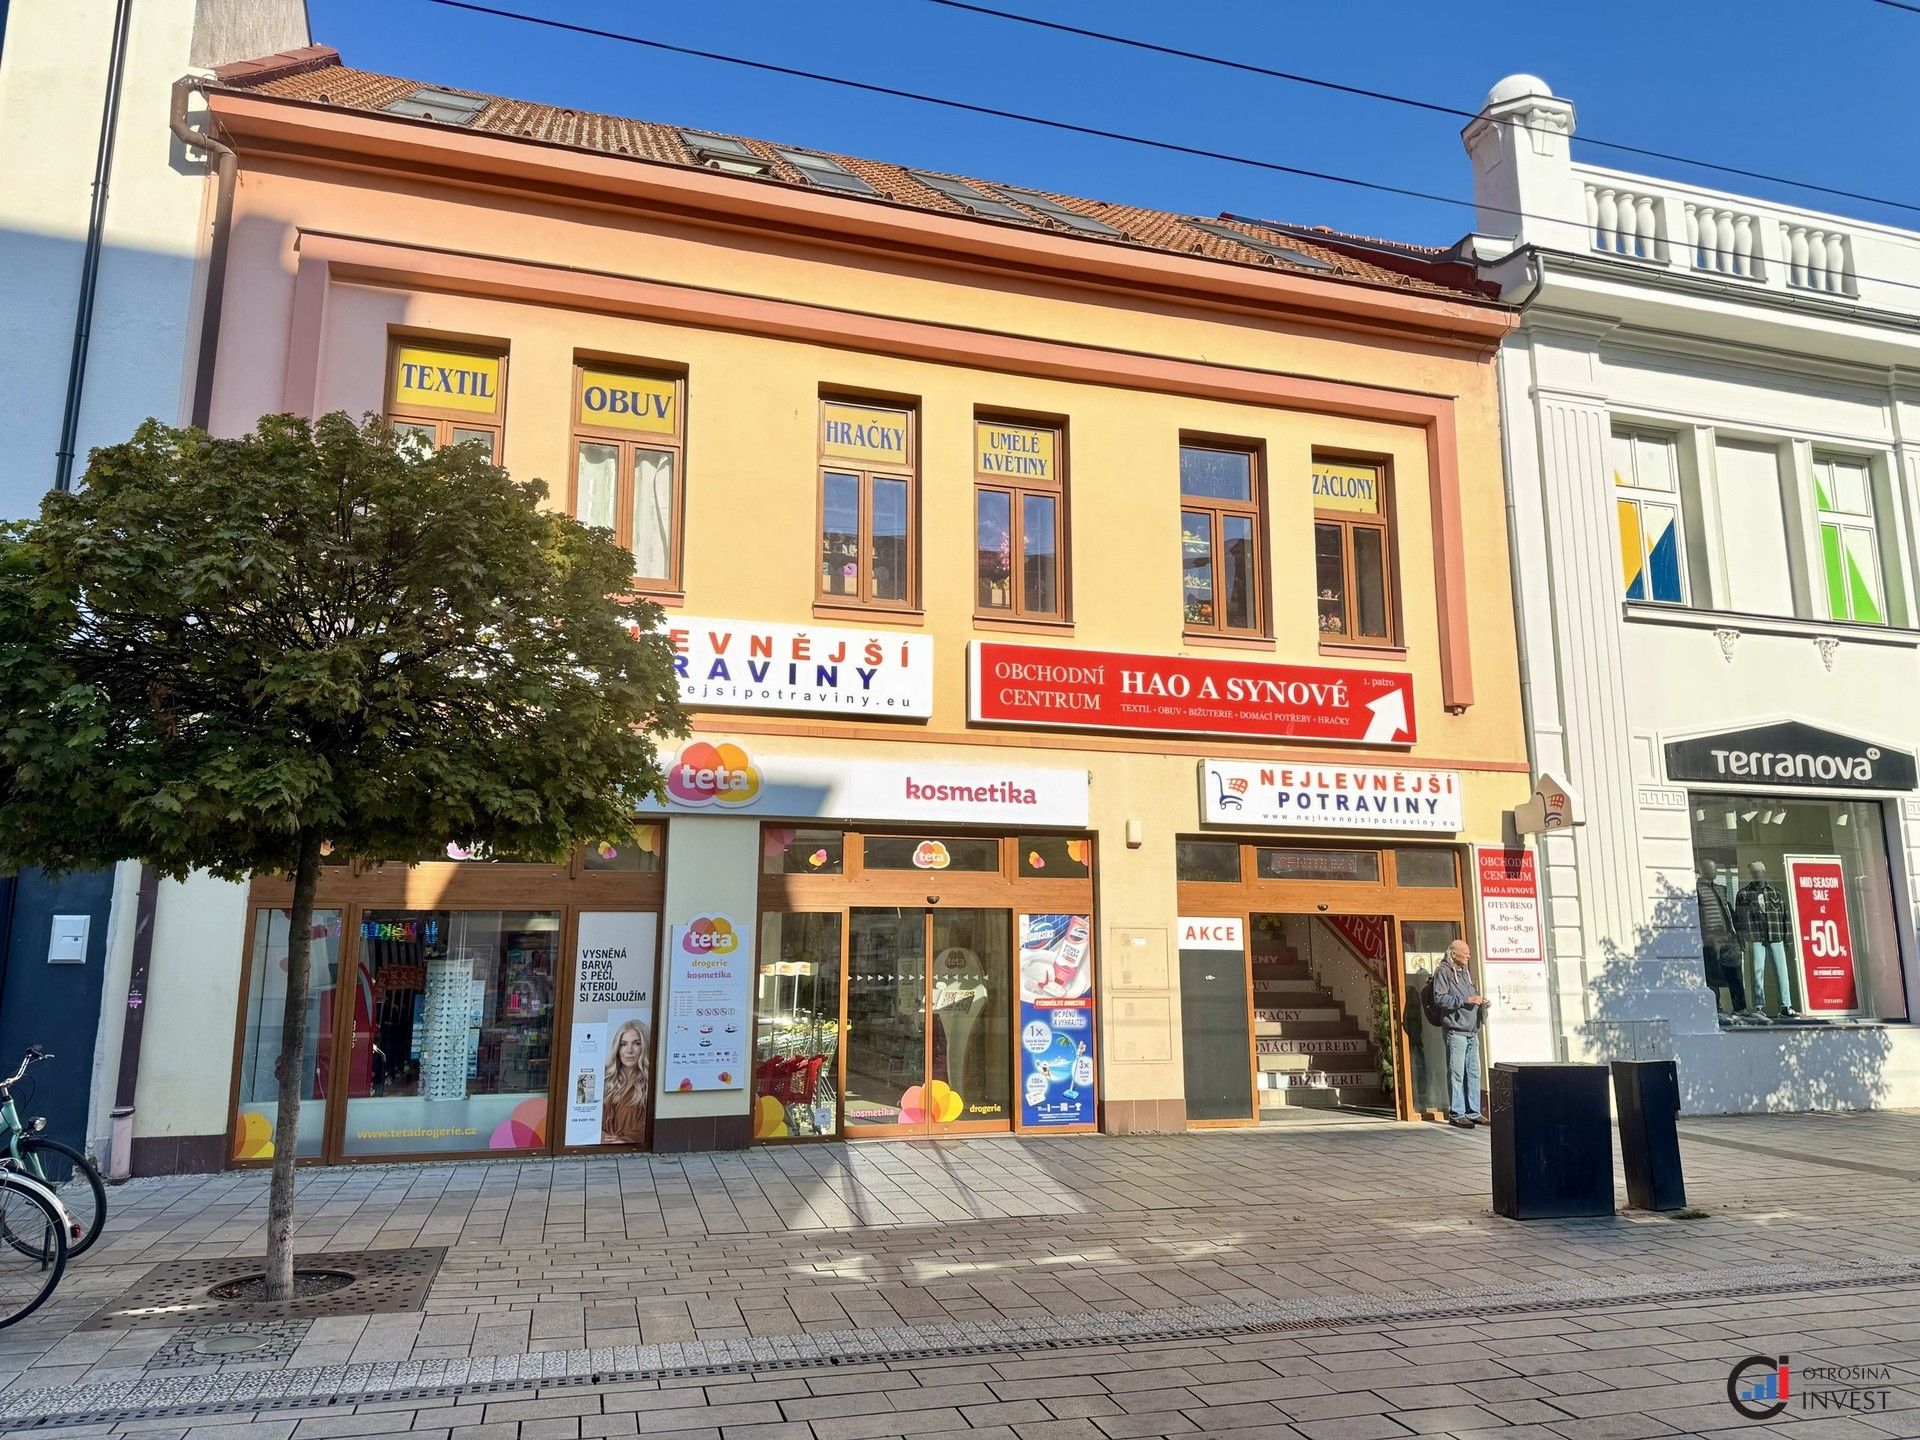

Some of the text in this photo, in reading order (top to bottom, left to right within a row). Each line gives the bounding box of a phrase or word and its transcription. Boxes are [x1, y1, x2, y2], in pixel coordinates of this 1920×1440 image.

[401, 362, 495, 399] TEXTIL
[584, 386, 673, 419] OBUV
[825, 419, 905, 451] HRAČKY
[990, 430, 1040, 454] UMĚLÉ
[982, 451, 1047, 477] KVĚTINY
[1312, 469, 1374, 500] ZÁCLONY
[995, 661, 1350, 708] OBCHODNÍ HAO A SYNOVÉ
[1372, 678, 1395, 688] patro
[999, 688, 1101, 711] CENTRUM
[1120, 703, 1350, 726] TEXTIL OBUV BIŽUTERIE DOMÁCÍ POTŘEBY HRAČKY
[680, 764, 750, 790] teta
[1260, 768, 1453, 794] NEJLEVNĚJŠÍ
[906, 776, 1037, 805] kosmetika
[1278, 791, 1438, 815] POTRAVINY
[919, 851, 944, 863] teta
[1480, 855, 1533, 868] OBCHODNÍ
[1483, 870, 1532, 882] CENTRUM
[1800, 876, 1839, 889] MID SEASON
[1483, 886, 1500, 894] HAO
[1507, 886, 1535, 895] SYNOVÉ
[1812, 889, 1830, 901] SALE
[1488, 901, 1533, 910] OTEVŘENO
[690, 931, 732, 947] teta
[1185, 925, 1236, 941] AKCE
[1803, 919, 1848, 957] -50%
[1508, 937, 1519, 945] Ne
[582, 947, 627, 959] VYSNĚNÁ
[581, 960, 613, 970] BARVA
[691, 958, 728, 968] drogerie
[581, 971, 587, 980] S
[686, 971, 732, 979] kosmetika
[580, 981, 618, 991] KTEROU
[580, 990, 646, 1002] SI ZASLOUŽÍM
[1256, 1040, 1293, 1052] MÁCÍ
[850, 1107, 895, 1118] kosmetika
[969, 1104, 1002, 1115] drogerie
[357, 1126, 478, 1139] www.tetadrogerie.cz
